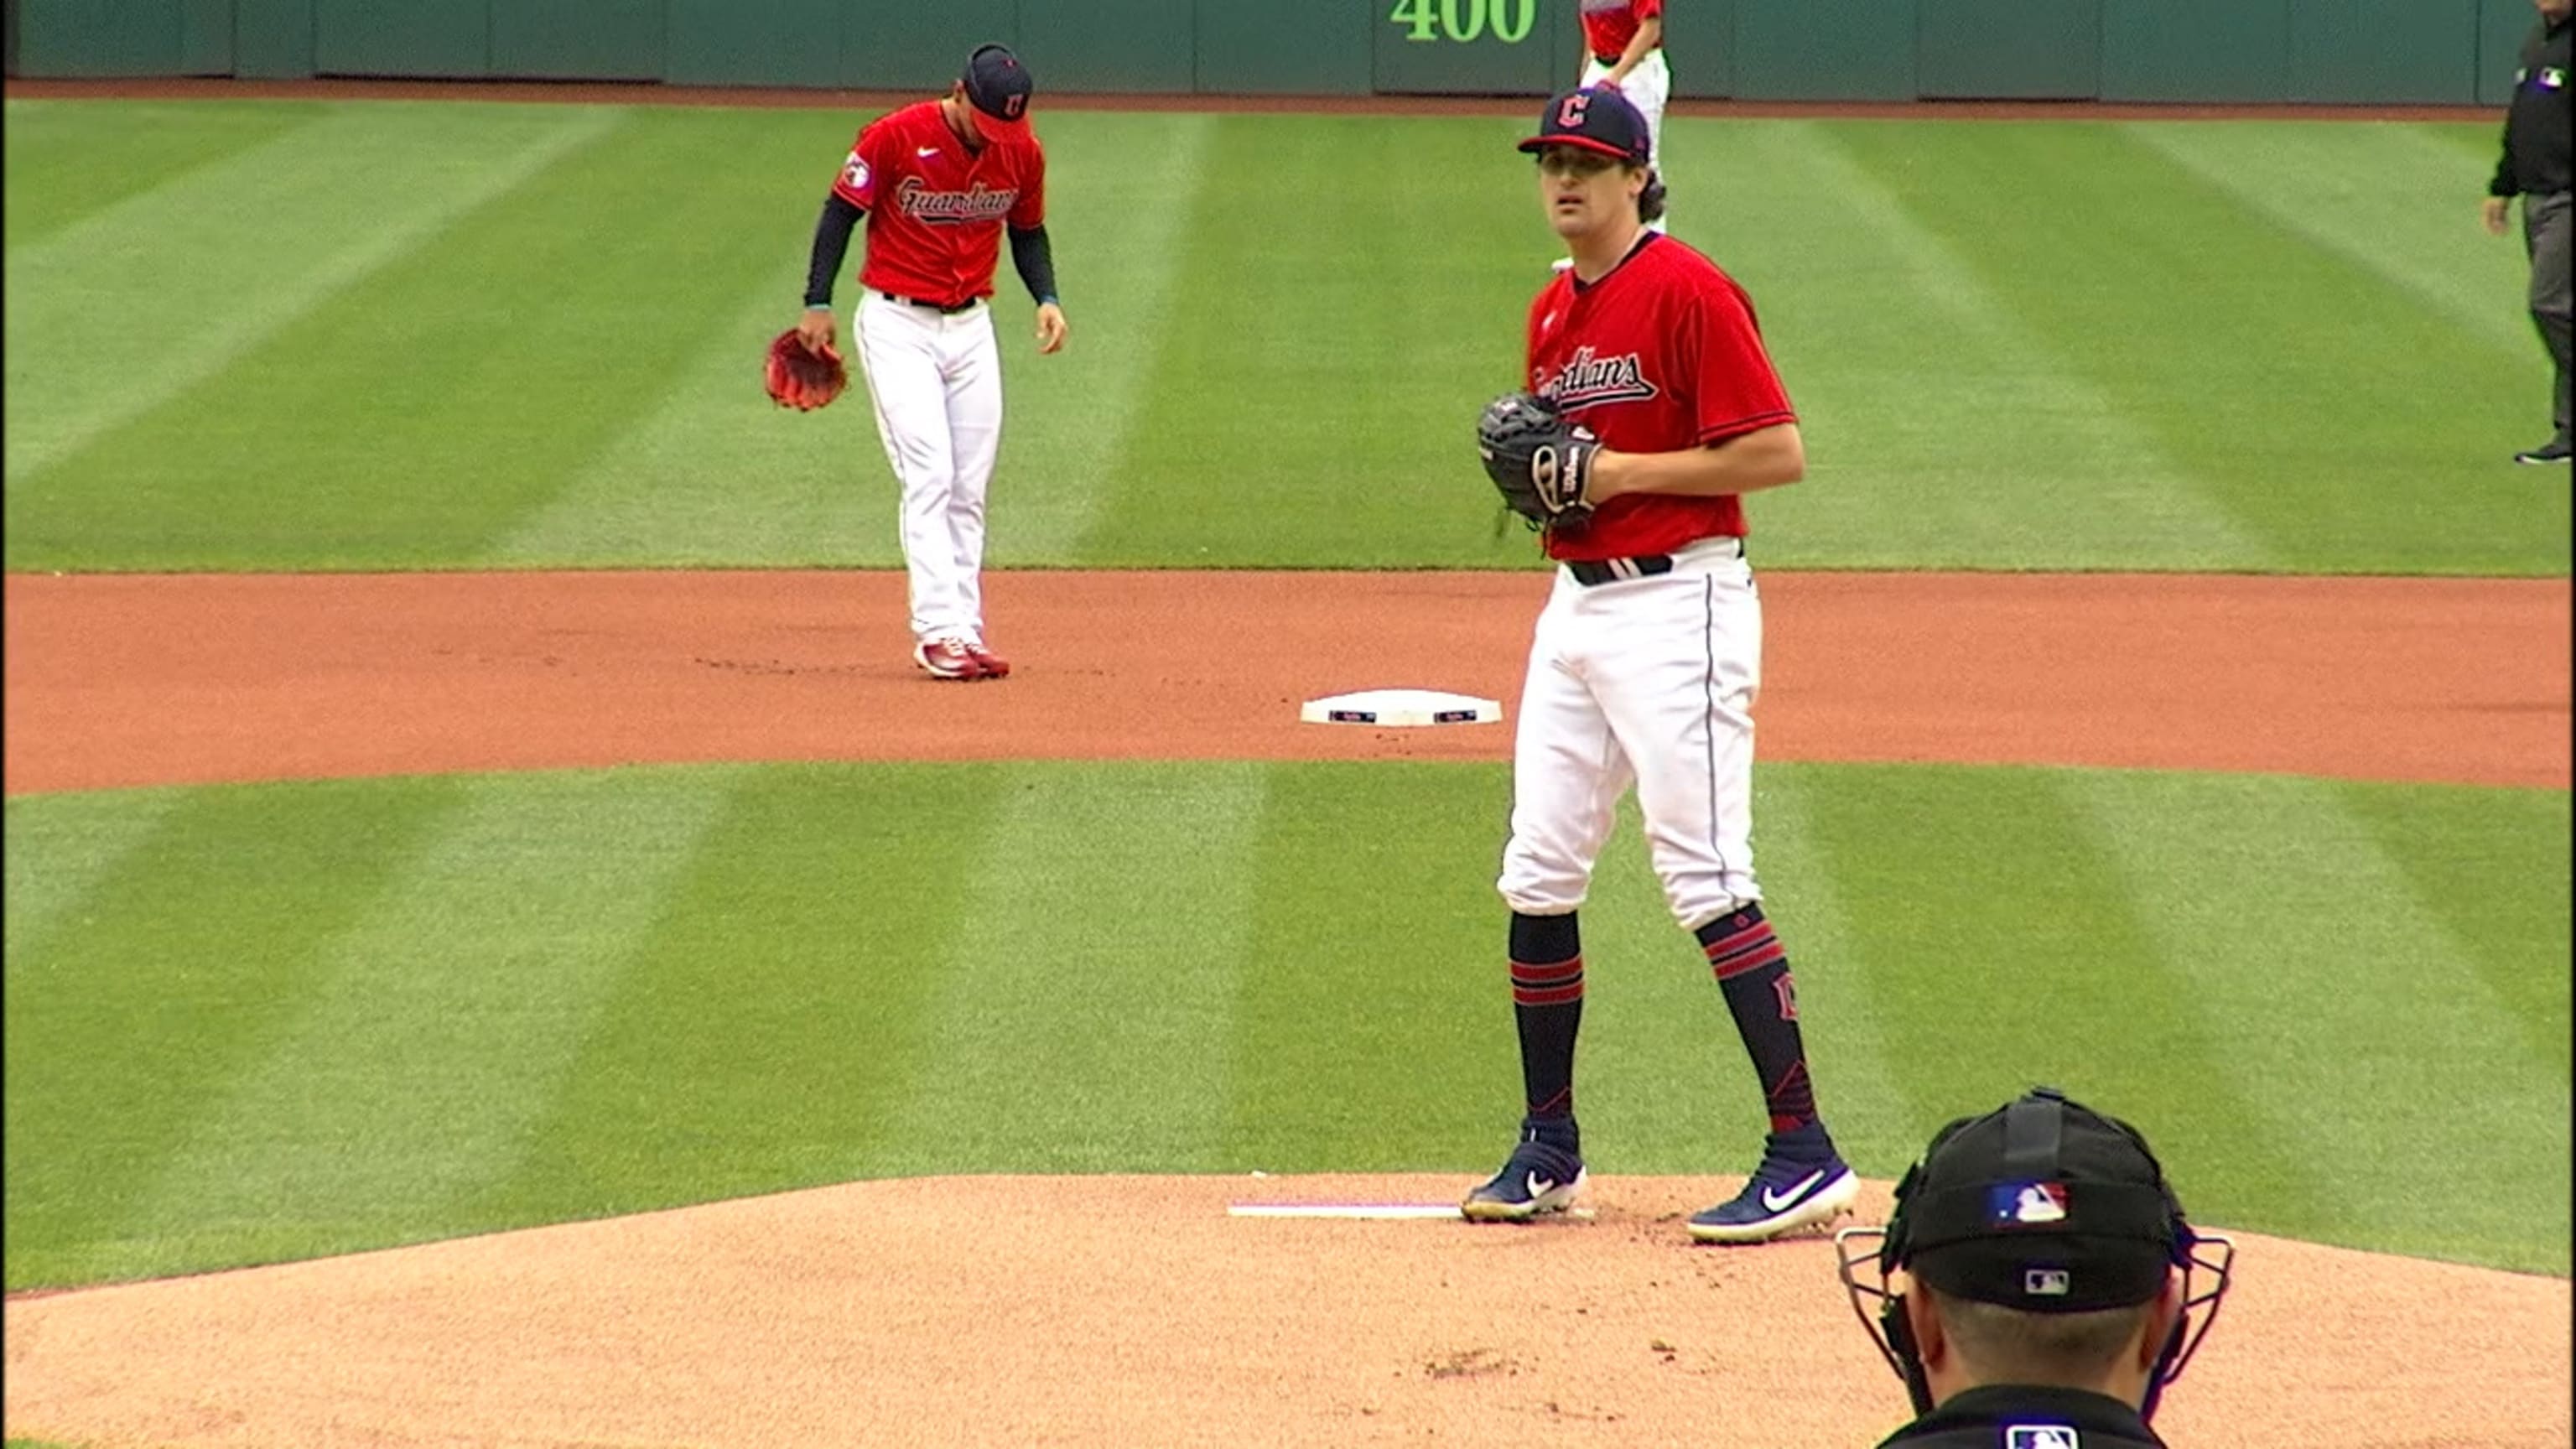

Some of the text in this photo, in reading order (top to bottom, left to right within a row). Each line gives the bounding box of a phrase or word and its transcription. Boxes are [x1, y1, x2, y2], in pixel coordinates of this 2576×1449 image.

[1390, 0, 1535, 42] 400
[1558, 94, 1591, 128] C
[1534, 345, 1659, 414] rdians
